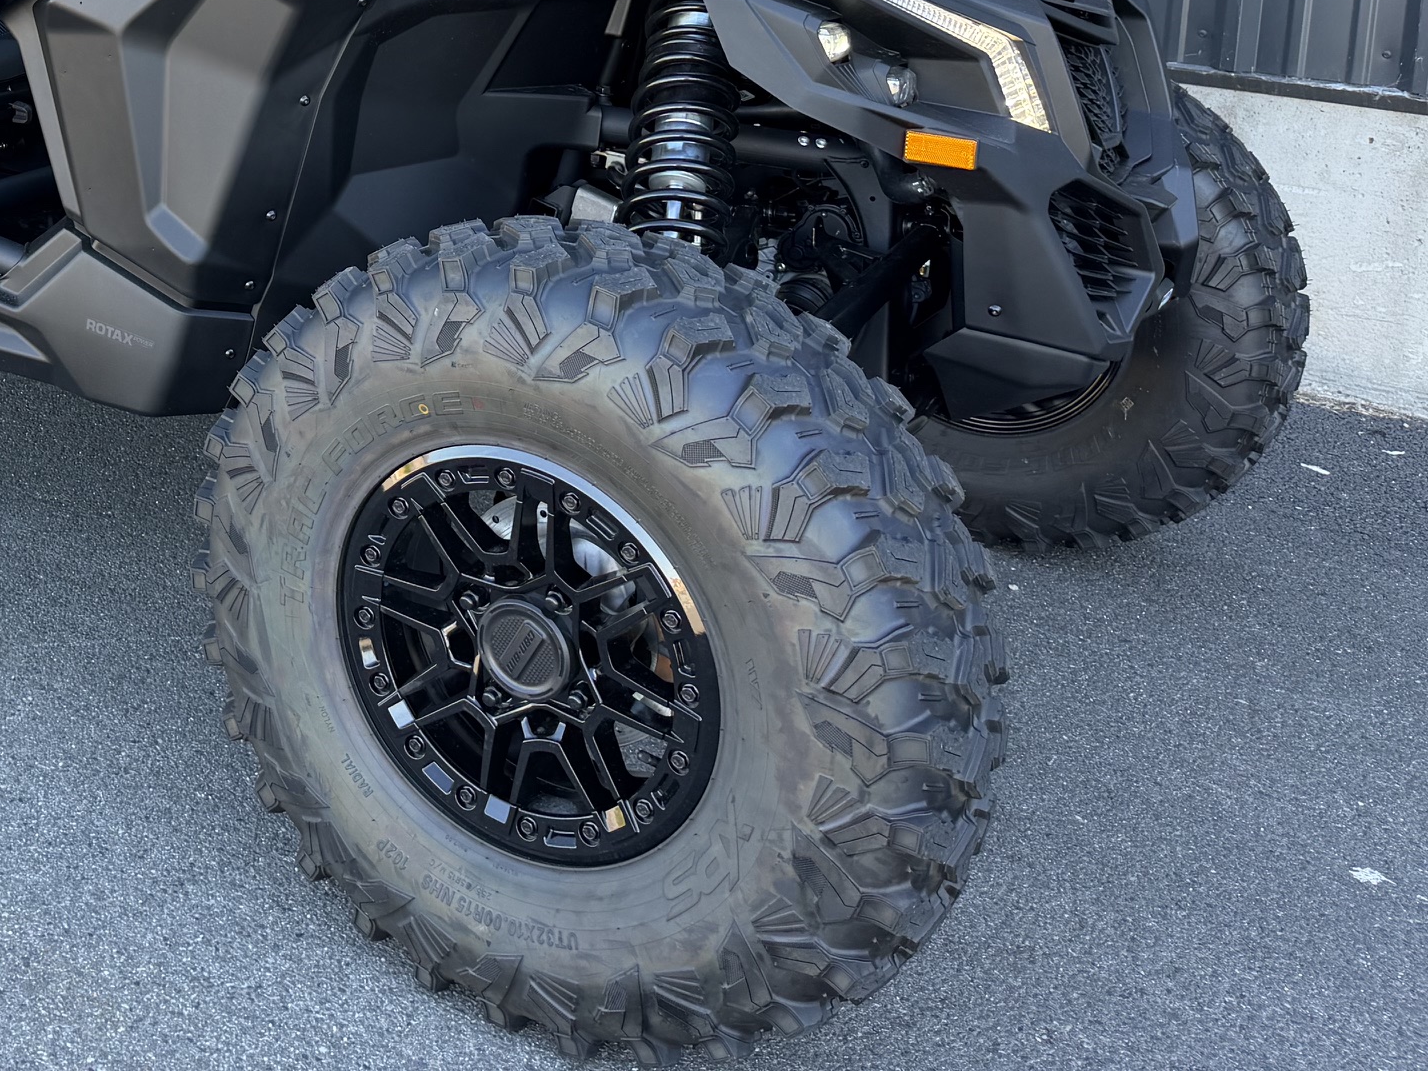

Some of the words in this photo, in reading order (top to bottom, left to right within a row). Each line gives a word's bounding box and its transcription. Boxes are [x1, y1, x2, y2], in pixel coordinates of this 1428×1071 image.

[85, 318, 132, 346] ROTAX
[321, 390, 464, 477] FORCE
[338, 753, 375, 799] RADIAL
[376, 838, 410, 871] 102P
[419, 872, 454, 909] NHS
[454, 894, 579, 951] UT32X10.00R15
